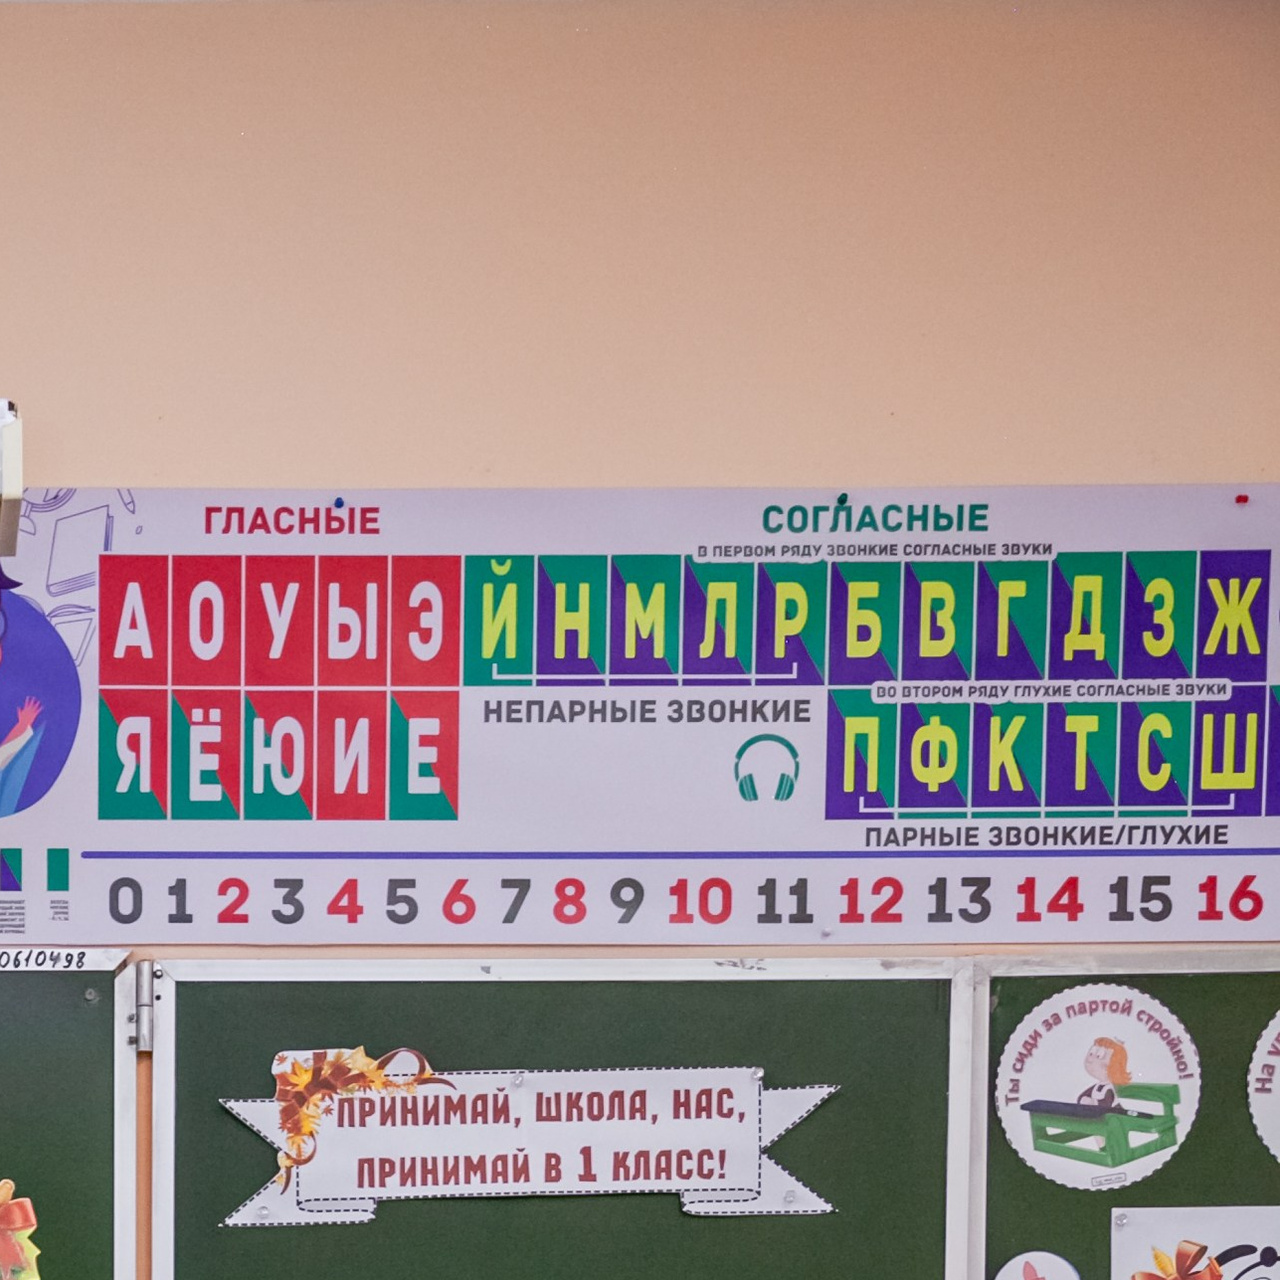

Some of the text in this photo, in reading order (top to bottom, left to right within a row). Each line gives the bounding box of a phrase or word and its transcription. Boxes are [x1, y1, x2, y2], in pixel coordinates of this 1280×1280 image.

[204, 506, 380, 535] ГЛАСНЫЕ
[762, 504, 989, 533] СОГЛАСНЫЕ
[698, 543, 1053, 557] В ПЕРВОМ РЯДУ ЗВОНКИЕ СОГЛАСНЫЕ ЗВУКИ
[114, 560, 1262, 661] А О У Ы Э Й Н М Л Р Б В Г Д З Ж
[877, 683, 1227, 698] ВО ВТОРОМ РЯДУ ГЛУХИЕ СОГЛАСНЫЕ ЗВУКИ
[484, 699, 811, 723] НЕПАРНЫЕ ЗВОНКИЕ
[115, 708, 441, 801] Я Ё Ю И Е
[843, 713, 1258, 793] П Ф К Т С Ш
[865, 824, 1229, 847] ПАРНЫЕ ЗВОНКИЕ/ГЛУХИЕ
[110, 878, 142, 924] 0
[168, 879, 193, 924] 1
[218, 878, 250, 924] 2
[272, 879, 305, 924] 3
[327, 879, 364, 924] 4
[386, 879, 418, 924] 5
[442, 880, 476, 924] 6
[501, 879, 531, 924] 7
[553, 878, 587, 924] 8
[610, 878, 645, 924] 9
[669, 878, 732, 924] 10
[757, 878, 814, 924] 11
[839, 877, 904, 923] 12
[927, 877, 992, 924] 13
[1017, 876, 1085, 922] 14
[1109, 875, 1173, 922] 15
[1198, 875, 1264, 921] 16
[1005, 998, 1194, 1107] Ты сиди за партой стройно!
[1254, 1063, 1276, 1094] На
[337, 1087, 746, 1128] ПРИНИМАЙ, ШКОЛА, НАС,
[357, 1146, 727, 1189] ПРИНИМАЙ В 1 КЛАСС!
